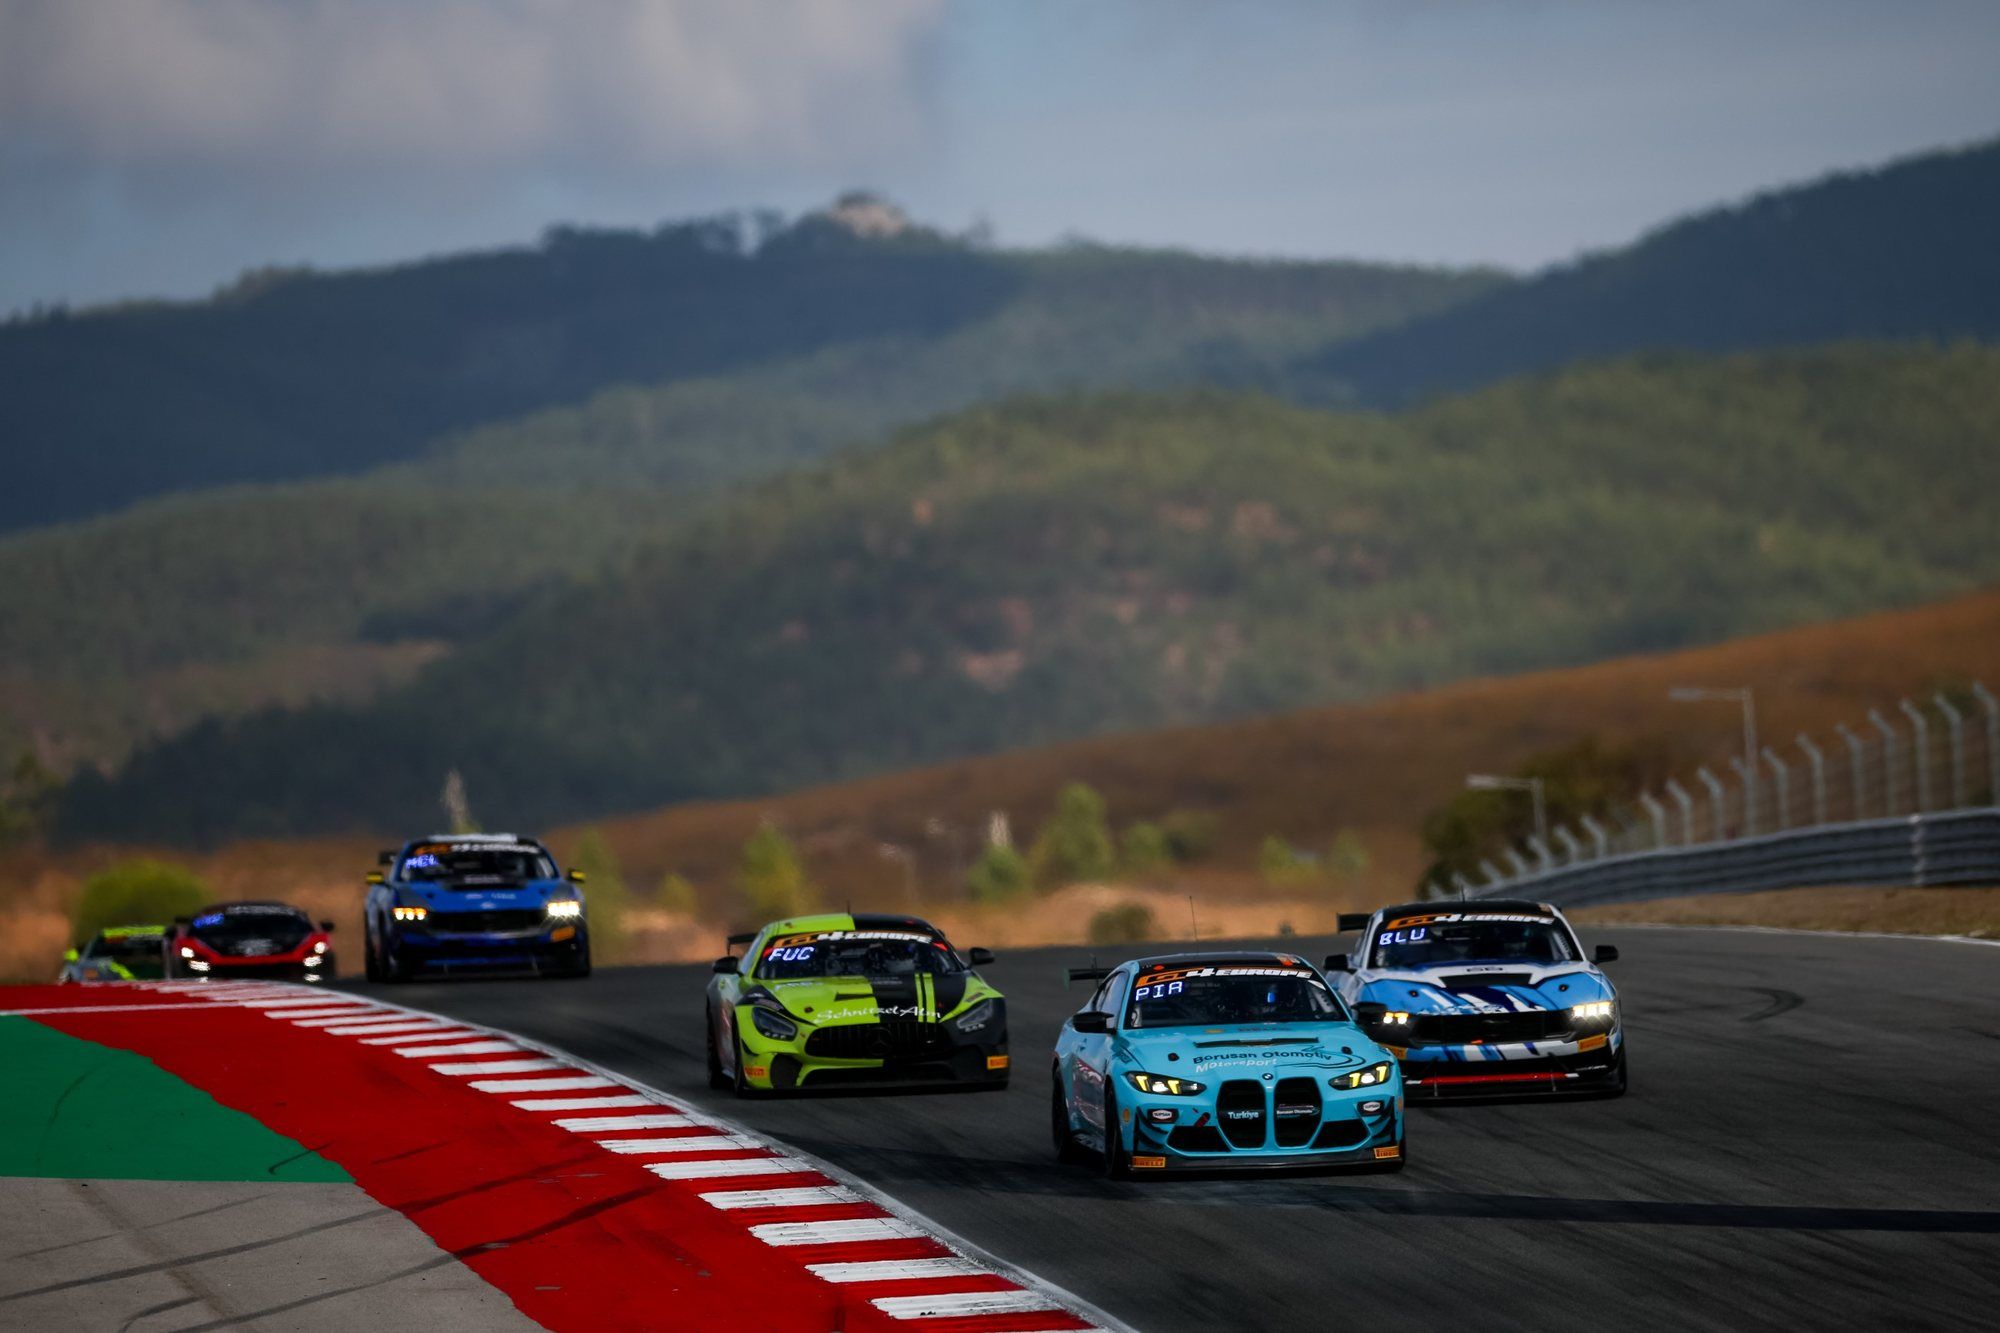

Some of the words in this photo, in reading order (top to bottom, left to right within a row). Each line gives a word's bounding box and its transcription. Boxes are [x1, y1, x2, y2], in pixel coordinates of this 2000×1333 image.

[1462, 914, 1555, 925] EUROPE
[845, 932, 933, 944] EUROPE
[1379, 928, 1426, 946] BLU
[768, 946, 815, 962] FUC
[1215, 968, 1313, 979] EUROPE
[1135, 981, 1183, 1001] PIA
[1193, 1052, 1257, 1064] Borusan
[1262, 1050, 1332, 1061] Otomotiv
[1195, 1058, 1278, 1073] Motorsport
